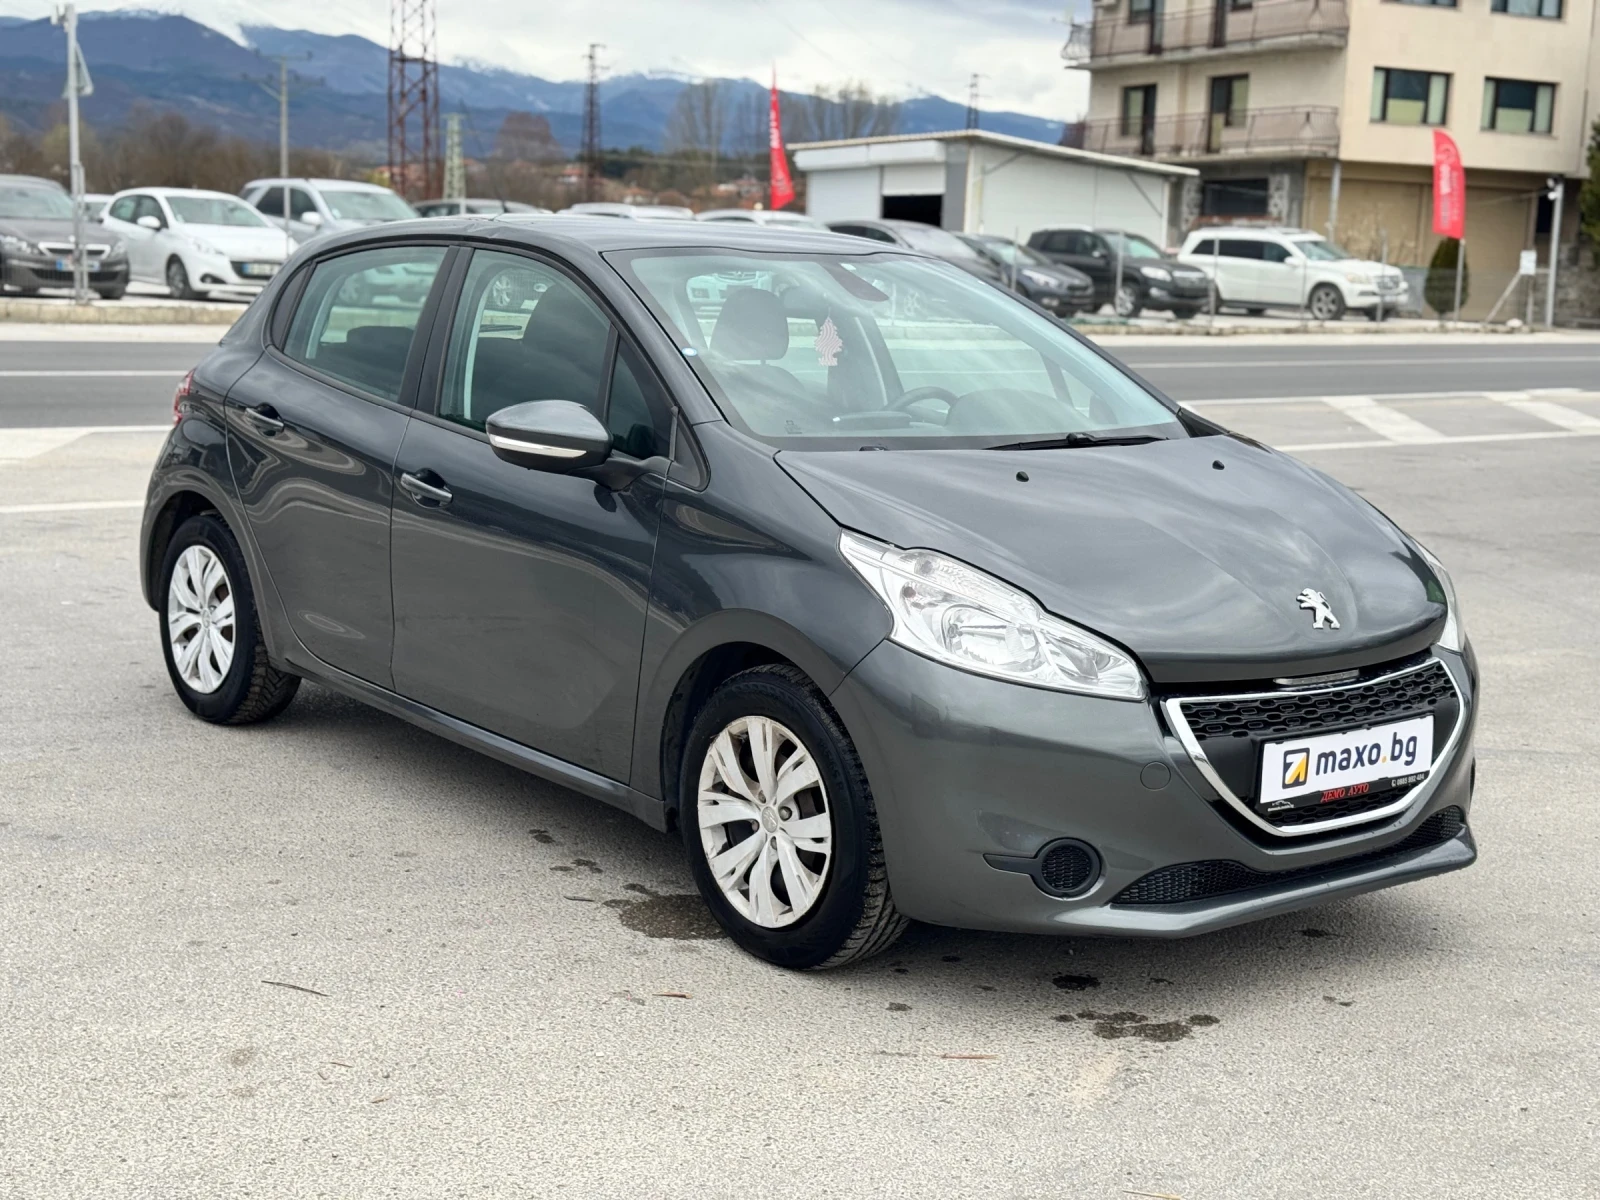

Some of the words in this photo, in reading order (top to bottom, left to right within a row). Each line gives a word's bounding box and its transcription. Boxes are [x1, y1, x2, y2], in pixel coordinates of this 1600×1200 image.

[1315, 731, 1418, 776] maxo.bg
[1320, 787, 1346, 803] ДЕМО
[1347, 782, 1370, 796] АУТО
